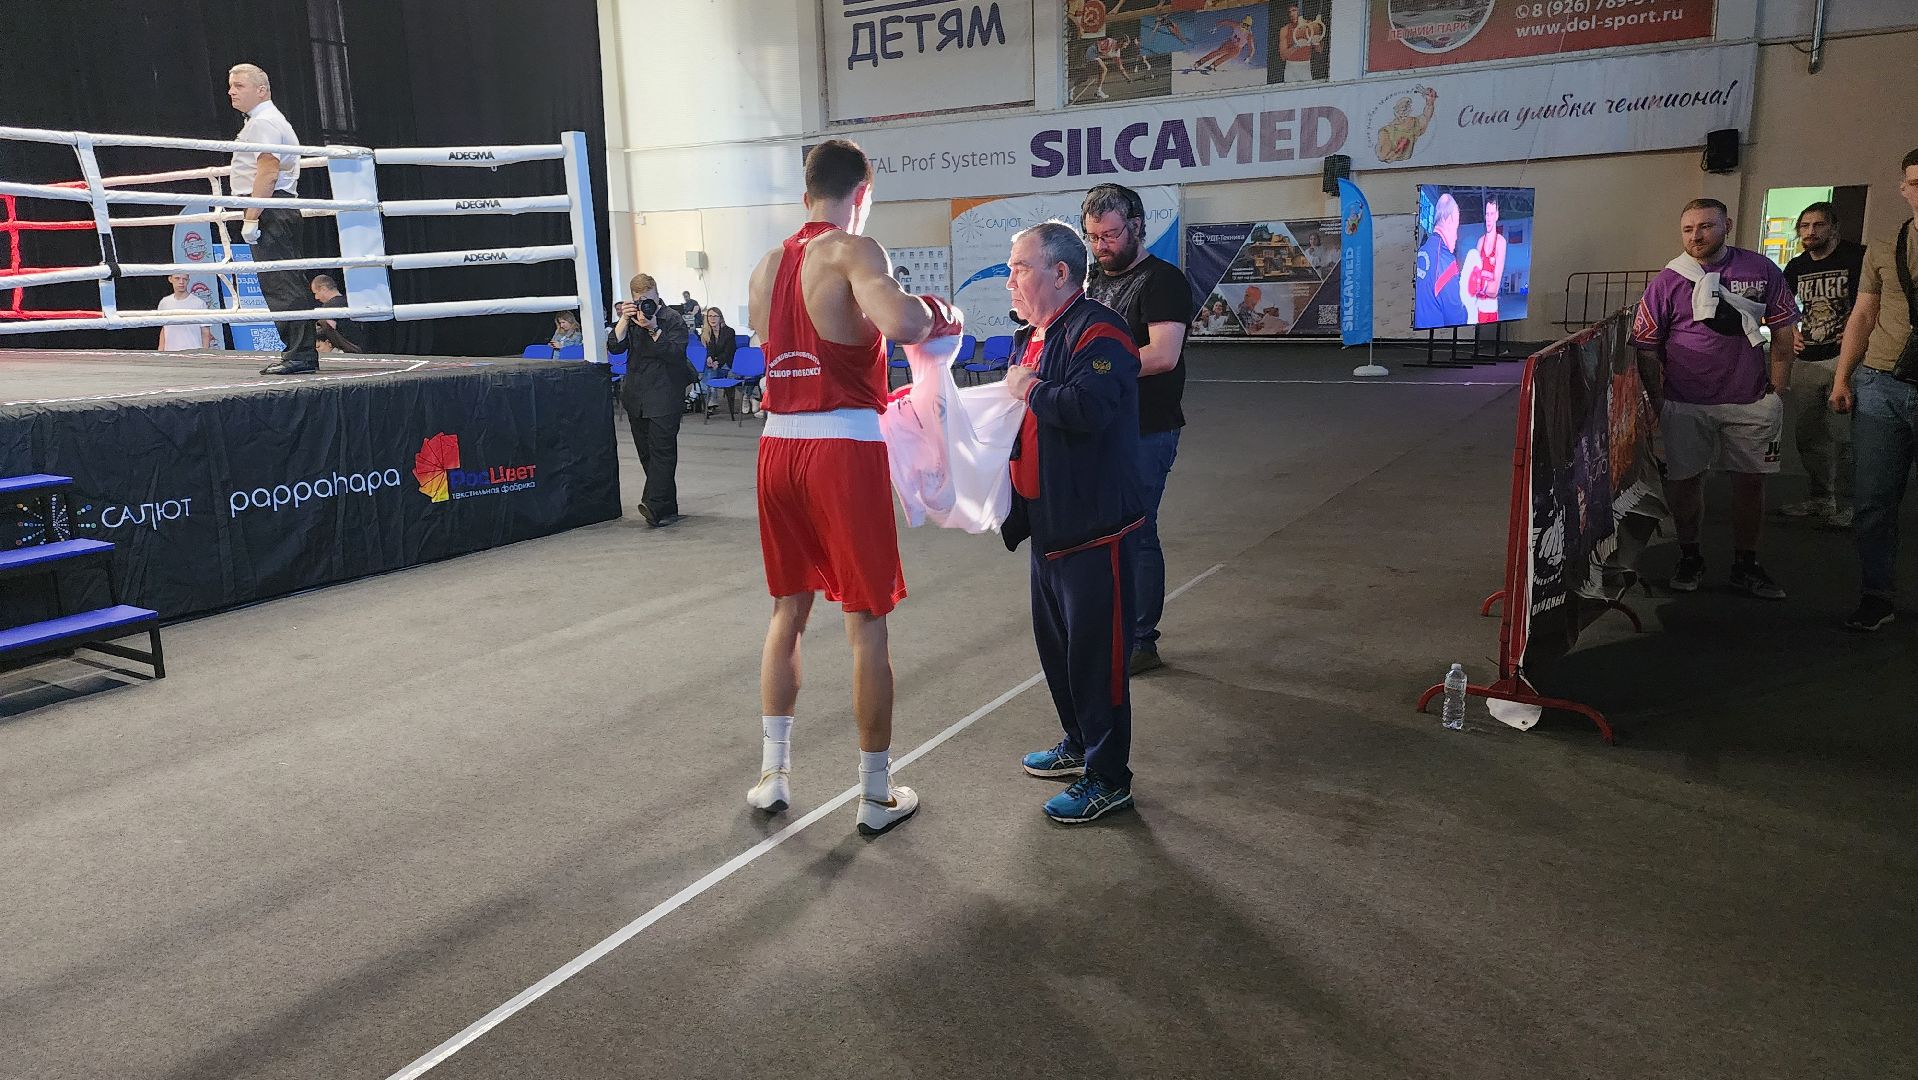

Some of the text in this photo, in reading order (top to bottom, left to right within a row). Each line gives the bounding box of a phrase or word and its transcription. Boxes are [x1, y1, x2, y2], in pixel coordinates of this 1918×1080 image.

[1532, 5, 1543, 17] 8
[1436, 21, 1470, 35] ПАРК
[1516, 7, 1684, 38] www.dol-sport.ru
[847, 2, 1006, 71] ДЕТЯМ
[1458, 104, 1509, 128] Сила
[1515, 93, 1597, 131] улыбки
[1604, 80, 1739, 114] чемпиона!
[1030, 105, 1349, 179] SILCAMED
[448, 150, 495, 162] ADEGMA
[869, 150, 1016, 174] TAL Prof Systems
[455, 198, 501, 210] ADEGMA
[1058, 214, 1081, 229] САЛ
[1145, 208, 1174, 223] ЛЮТ
[985, 217, 1022, 232] САЛЮТ
[463, 251, 508, 263] ADEGMA
[1343, 247, 1354, 331] SILCAMED
[988, 316, 1012, 329] САЛ
[452, 481, 536, 500] текстильная фабрика
[101, 497, 192, 531] САЛЮТ
